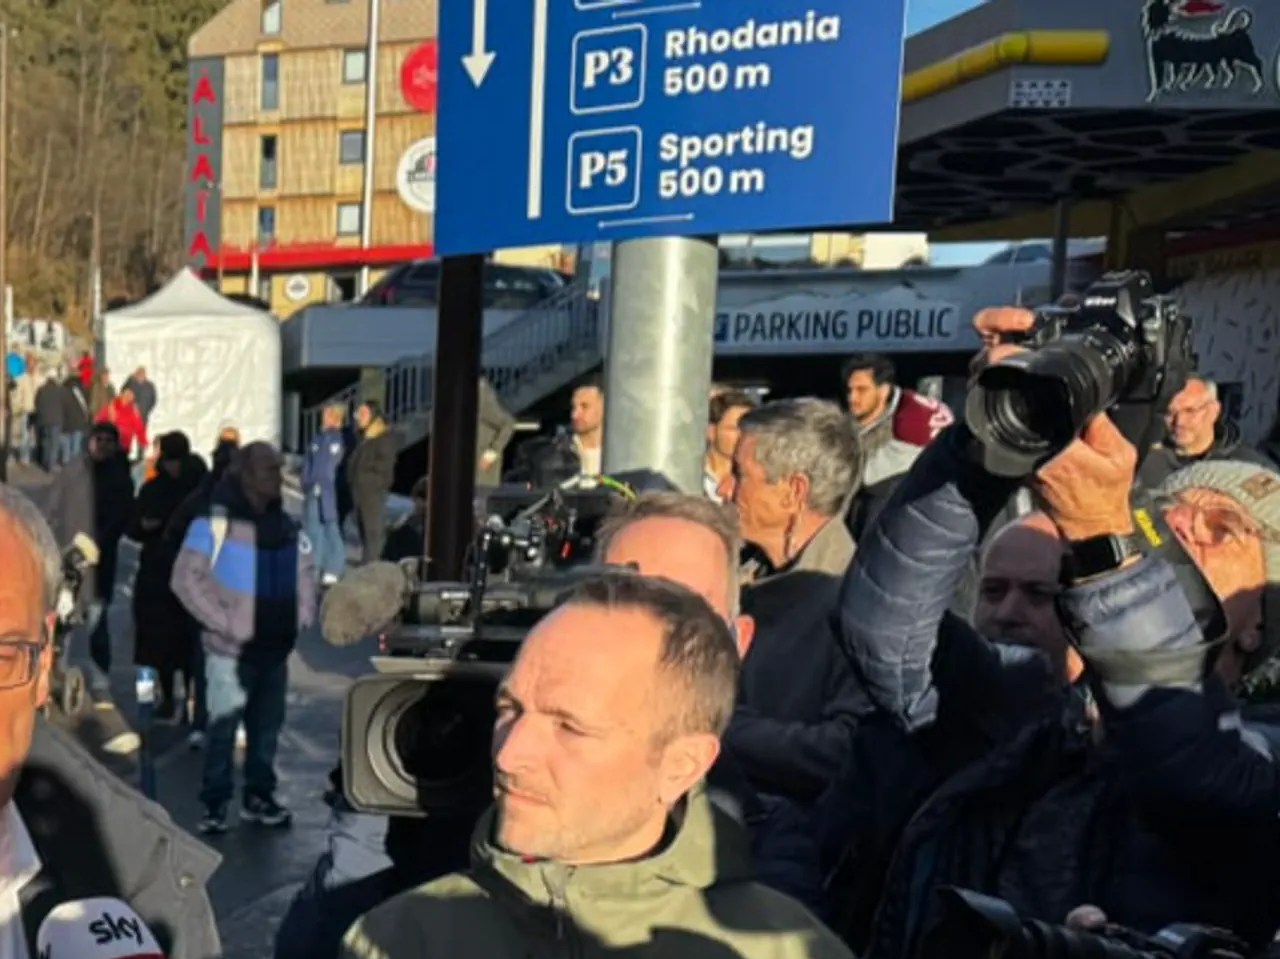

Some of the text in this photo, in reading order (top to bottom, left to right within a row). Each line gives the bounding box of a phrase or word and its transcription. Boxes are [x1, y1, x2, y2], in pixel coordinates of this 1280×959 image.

[664, 10, 840, 58] Rhodania
[582, 47, 634, 88] P3
[663, 62, 770, 96] 500 m
[659, 121, 815, 168] Sporting
[579, 149, 628, 189] P5
[658, 166, 764, 198] 500 m
[733, 310, 848, 342] PARKING
[855, 308, 954, 340] PUBLIC
[88, 911, 144, 946] sky
